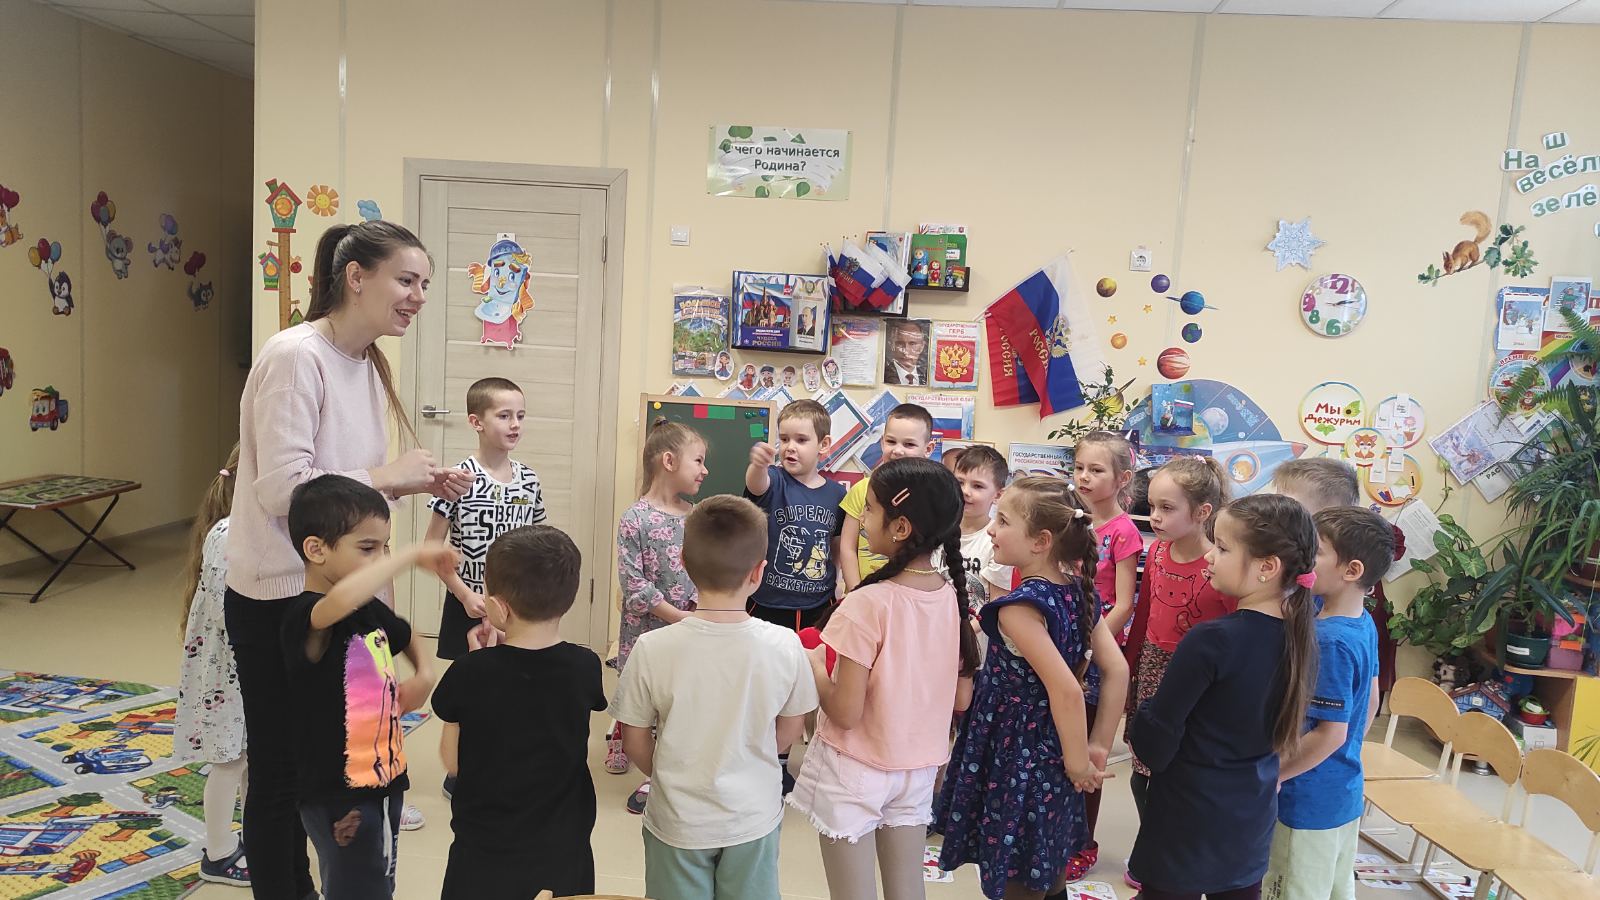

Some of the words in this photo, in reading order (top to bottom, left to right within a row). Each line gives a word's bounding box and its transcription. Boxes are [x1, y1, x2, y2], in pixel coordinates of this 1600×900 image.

[735, 146, 763, 155] чего
[766, 147, 840, 158] начинается
[754, 159, 807, 171] Родина?
[1519, 154, 1600, 193] весёл
[1315, 402, 1341, 415] Мы
[1304, 413, 1361, 426] Дежурим
[1012, 451, 1061, 460] ГОСУДАРСТВЕННЫЙ
